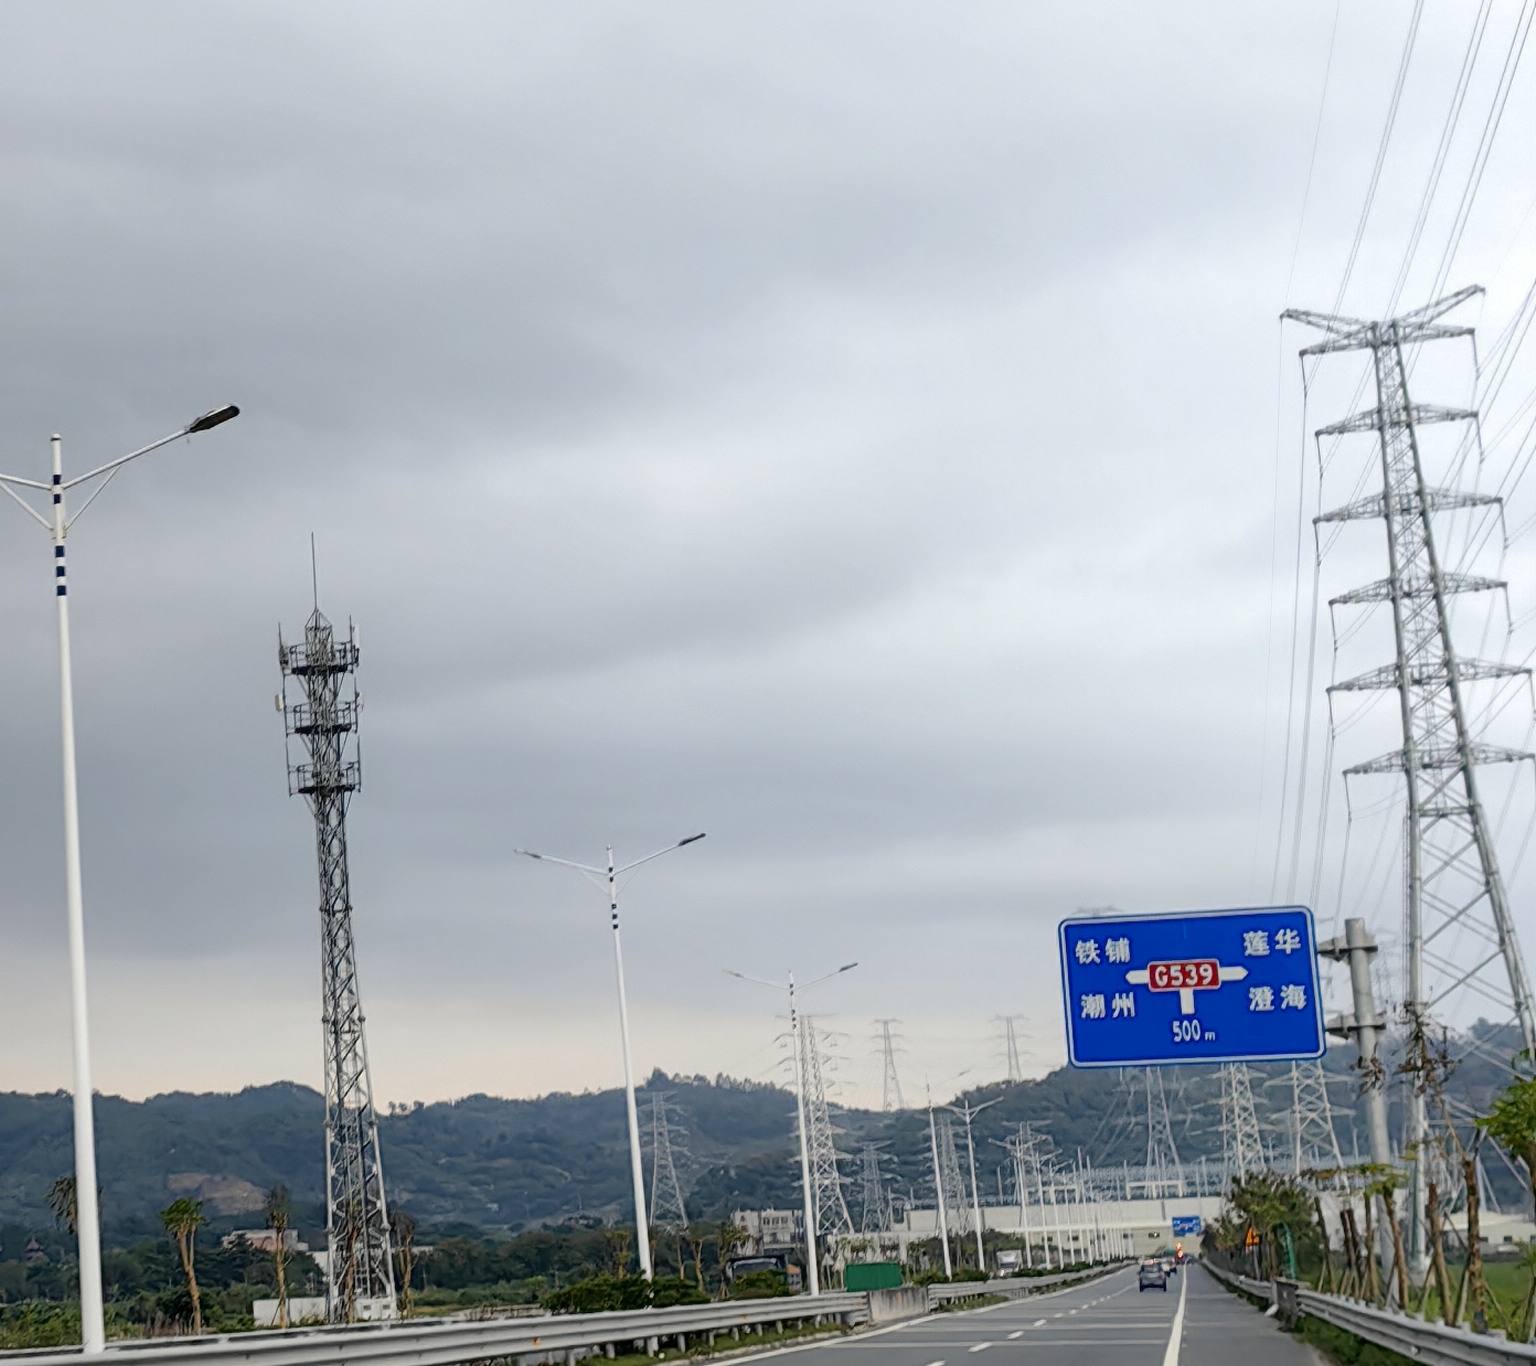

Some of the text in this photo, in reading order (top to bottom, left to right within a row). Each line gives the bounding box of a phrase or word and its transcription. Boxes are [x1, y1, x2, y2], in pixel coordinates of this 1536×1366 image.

[1075, 938, 1131, 964] 铁铺
[1243, 928, 1302, 956] 莲华
[1154, 964, 1213, 987] G539
[1080, 992, 1136, 1019] 潮州
[1249, 984, 1307, 1012] 澄海
